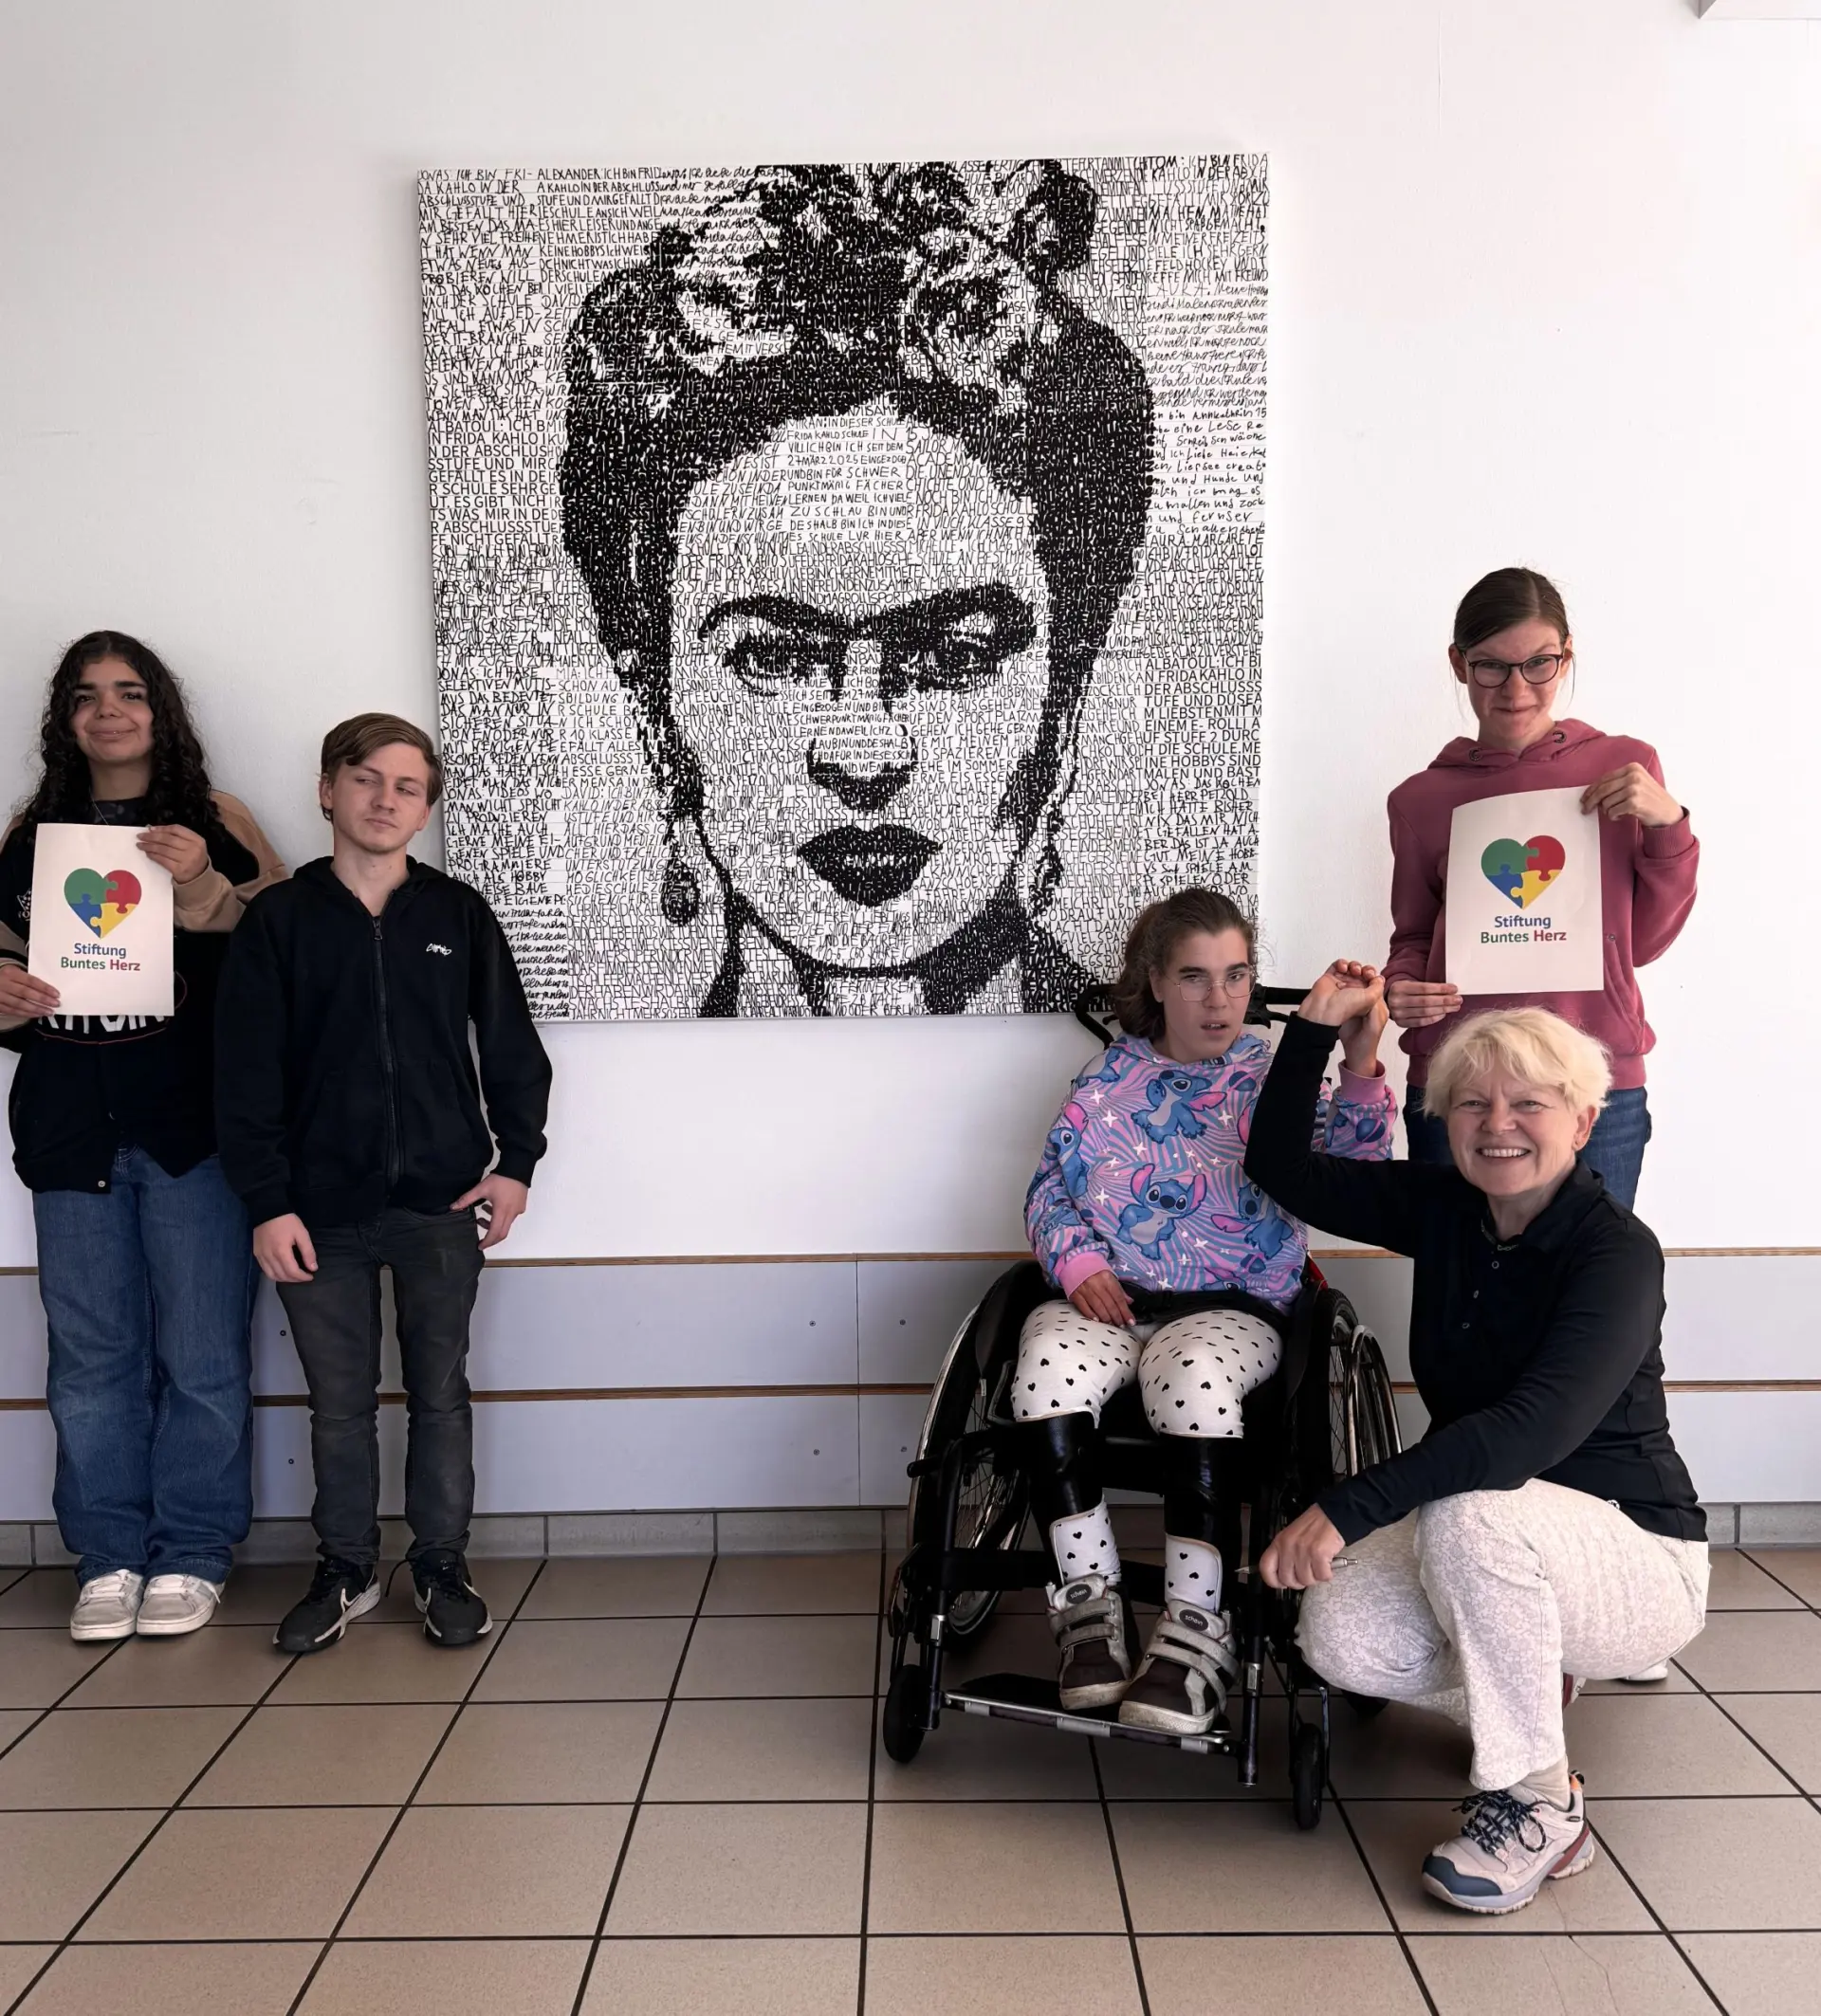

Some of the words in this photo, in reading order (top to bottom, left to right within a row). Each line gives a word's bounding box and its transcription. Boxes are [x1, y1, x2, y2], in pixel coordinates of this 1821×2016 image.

[475, 169, 497, 180] BIN
[420, 220, 436, 233] AM
[488, 219, 509, 233] DAS
[436, 231, 468, 245] SEHR
[472, 232, 497, 245] VIEL
[509, 420, 531, 431] ICH
[429, 432, 441, 445] IN
[446, 432, 486, 444] FRIDA
[493, 432, 538, 444] KAHLO
[443, 445, 469, 457] DER
[475, 445, 547, 457] ABSCHLUS
[845, 441, 862, 452] ICH
[887, 442, 903, 451] DEM
[429, 458, 480, 469] SSTUFE
[485, 458, 514, 469] UND
[522, 458, 546, 469] MIR
[489, 470, 506, 482] ES
[510, 470, 524, 482] IN
[443, 483, 496, 495] SCHULE
[501, 483, 538, 495] SEHR
[856, 480, 904, 491] FÄCHER
[454, 496, 470, 507] ES
[474, 496, 506, 507] GIBT
[512, 495, 545, 506] NICH
[789, 494, 827, 504] LERNEN
[431, 508, 446, 521] TS
[450, 508, 479, 521] WAS
[485, 508, 509, 520] MIR
[514, 508, 526, 521] IN
[874, 531, 904, 541] HIER
[1222, 656, 1244, 668] ICH
[483, 667, 501, 678] ICH
[506, 667, 537, 678] HABE
[1159, 670, 1197, 682] FRIDA
[1200, 669, 1244, 681] KAHLO
[1249, 669, 1261, 680] IN
[1145, 684, 1171, 695] DER
[1145, 695, 1179, 706] TUFE
[1185, 694, 1213, 706] UND
[1159, 706, 1222, 719] LIEBSTEN
[1224, 705, 1248, 717] MIT
[1146, 720, 1186, 731] EINEM
[1208, 718, 1245, 730] ROLLI
[1165, 731, 1205, 743] STUFE
[1223, 729, 1260, 742] DURC
[1159, 743, 1180, 755] DIE
[1145, 757, 1167, 768] INE
[1171, 756, 1225, 767] HOBBYS
[1229, 755, 1261, 766] SIND
[1144, 768, 1188, 779] MALEN
[1194, 767, 1223, 778] UND
[1227, 766, 1260, 777] BAST
[1176, 813, 1197, 826] DAS
[470, 823, 512, 835] MACHE
[518, 823, 548, 835] AUCH
[1145, 839, 1168, 851] BER
[540, 846, 564, 858] UND
[1495, 915, 1552, 929] Stiftung
[1481, 931, 1529, 944] Buntes
[1534, 930, 1567, 942] Herz
[74, 943, 127, 959] Stiftung
[61, 957, 106, 970] Buntes
[110, 960, 141, 971] Herz
